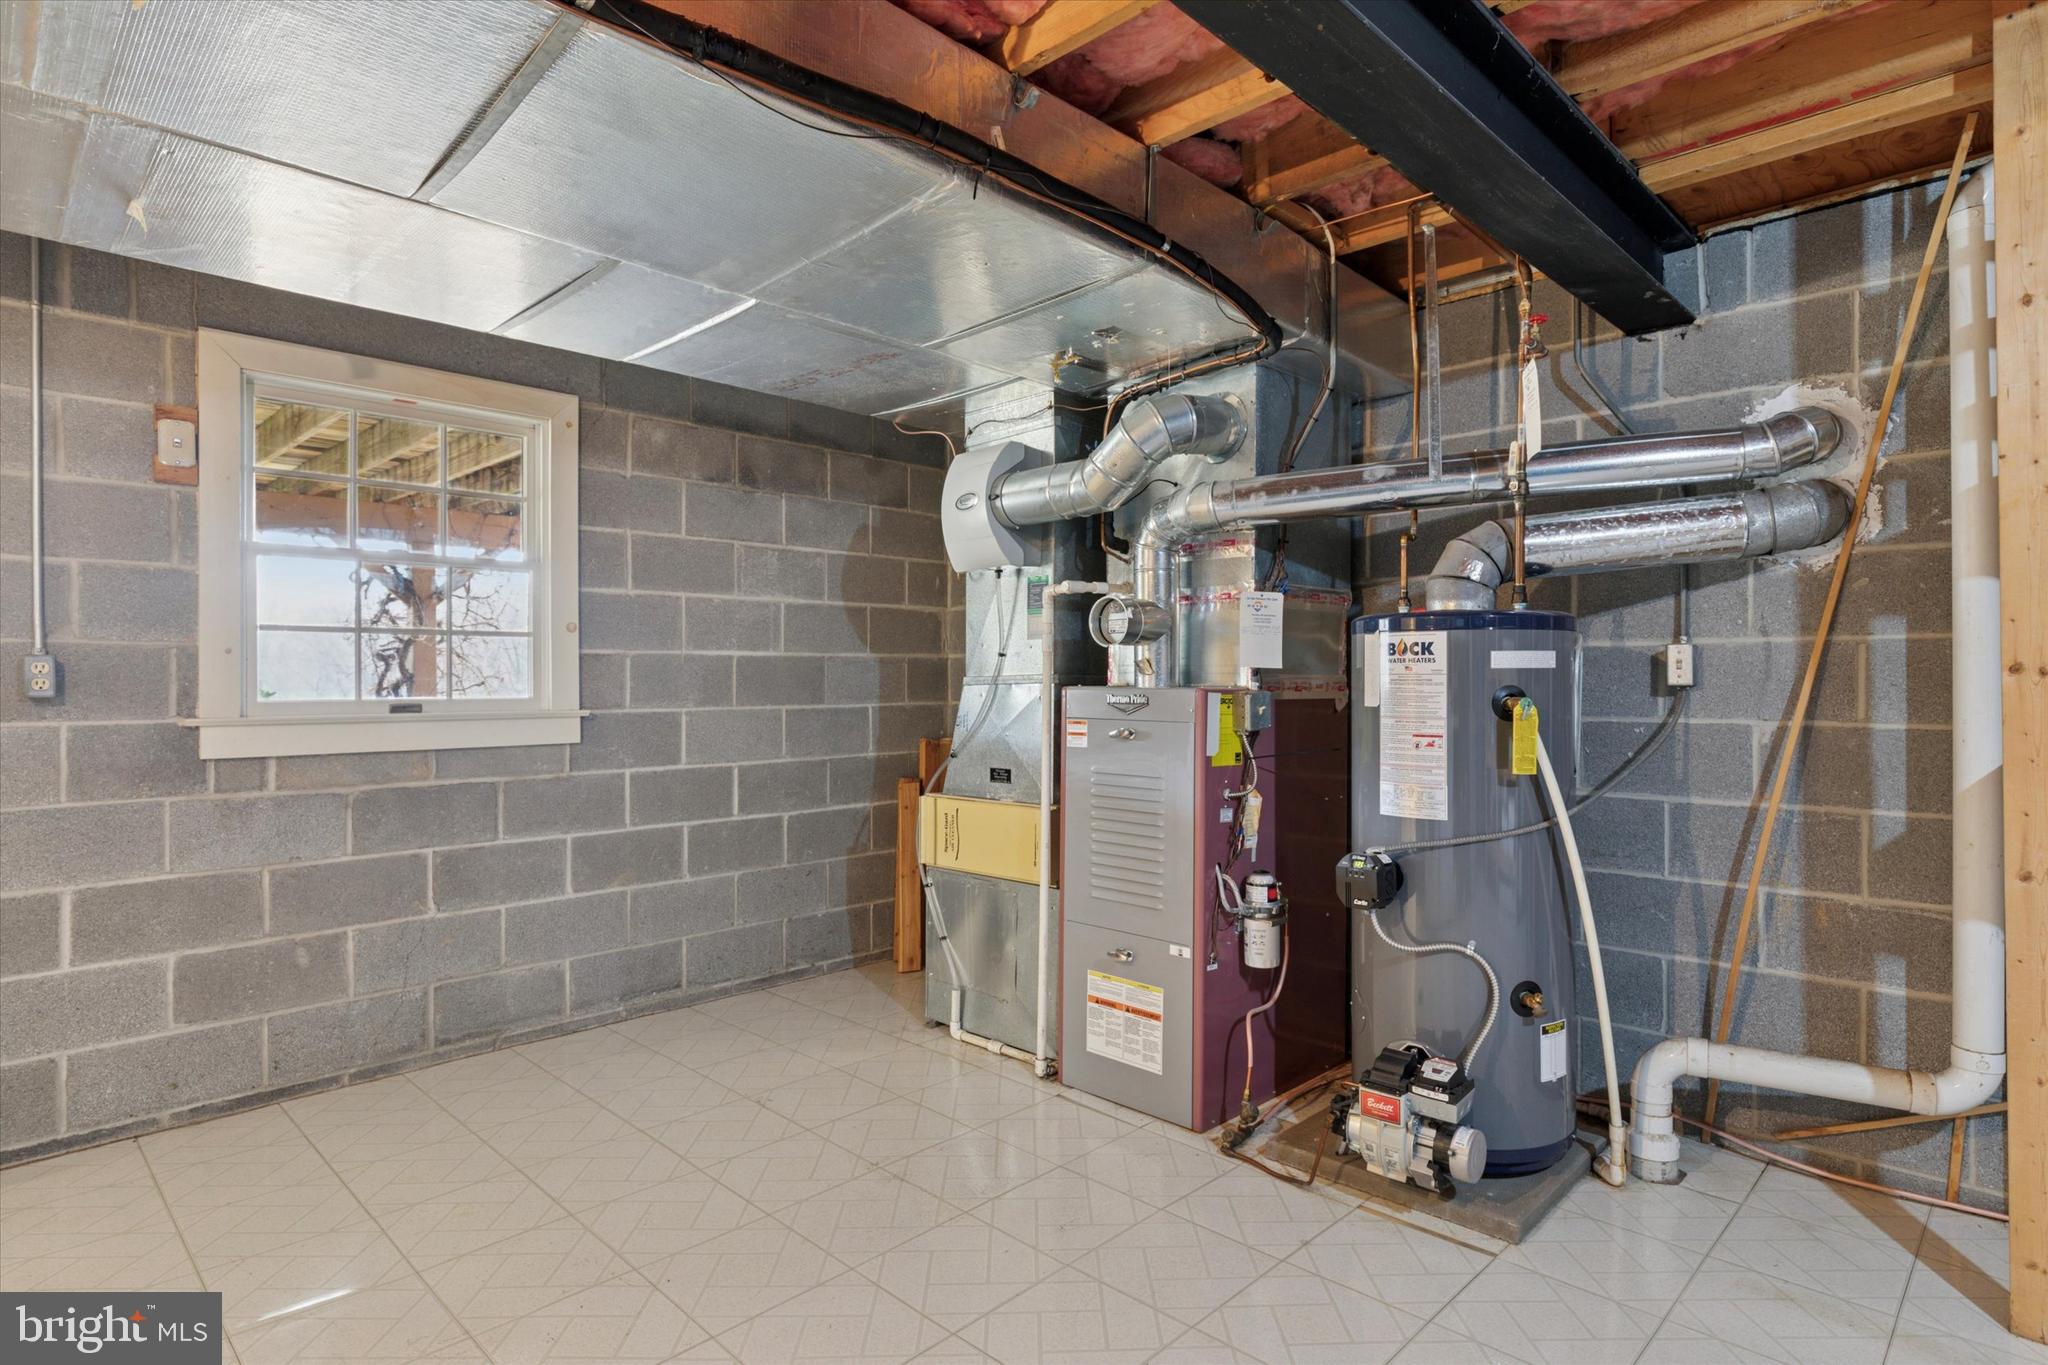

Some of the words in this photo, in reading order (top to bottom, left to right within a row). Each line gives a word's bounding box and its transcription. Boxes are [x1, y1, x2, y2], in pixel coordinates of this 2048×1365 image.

[1388, 639, 1435, 657] BOCK
[1106, 693, 1130, 704] Thermo
[1130, 694, 1148, 705] Pride
[1366, 1097, 1395, 1113] Beckett
